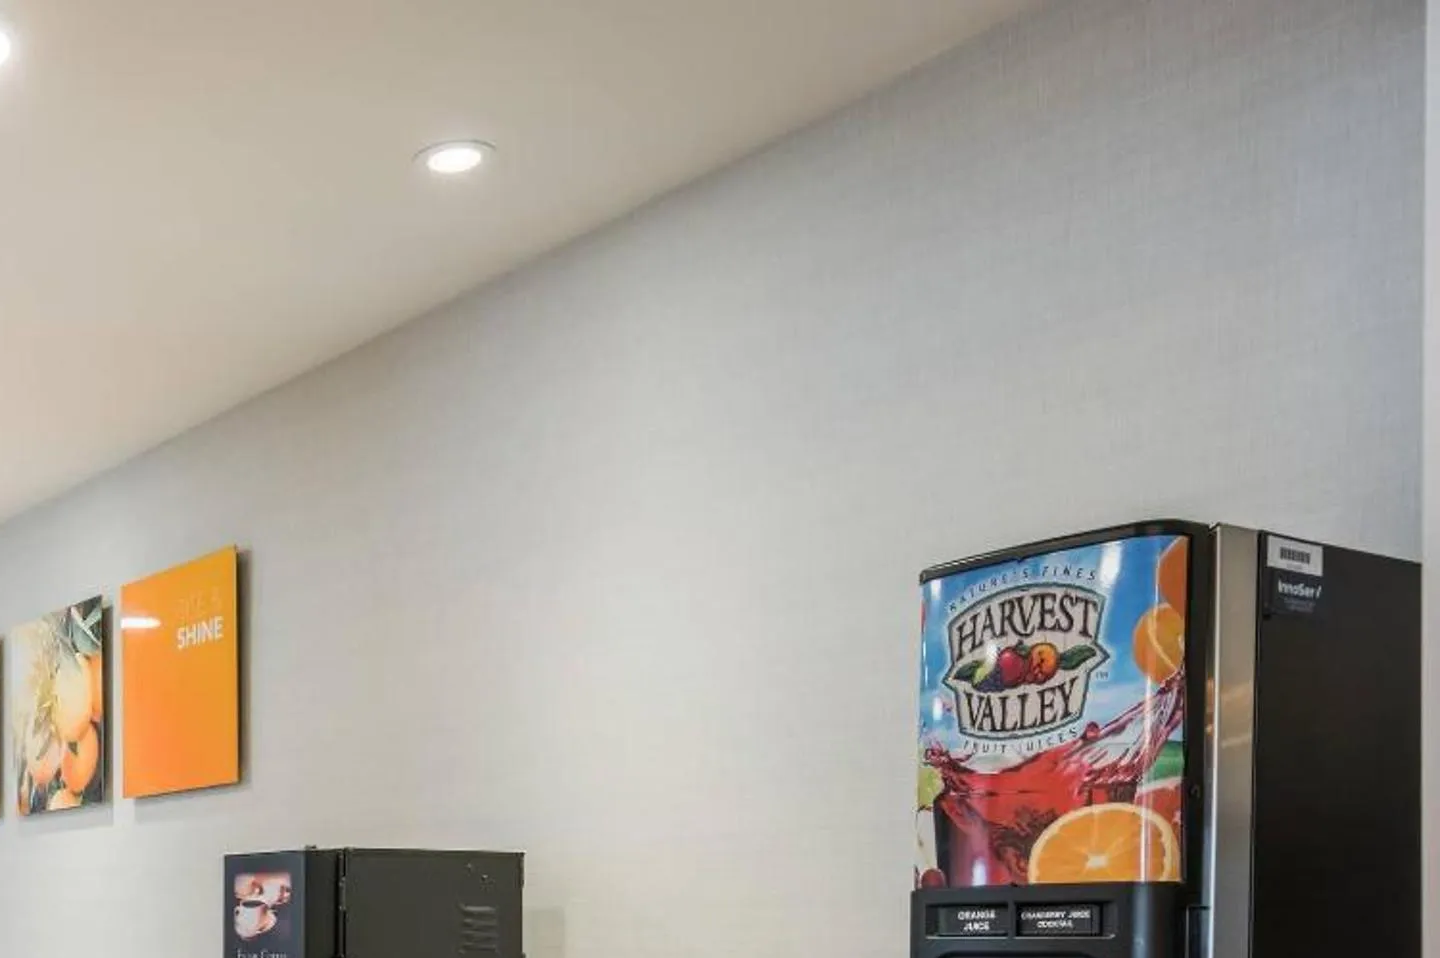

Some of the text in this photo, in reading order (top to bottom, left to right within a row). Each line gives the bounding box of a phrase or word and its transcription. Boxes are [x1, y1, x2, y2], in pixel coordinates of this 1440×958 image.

[1041, 564, 1102, 584] FINES
[176, 615, 224, 651] SHINE
[955, 592, 1099, 662] HARVEST
[964, 677, 1080, 732] VALLEY
[963, 738, 1007, 754] FRUIT
[963, 920, 991, 932] JUICE
